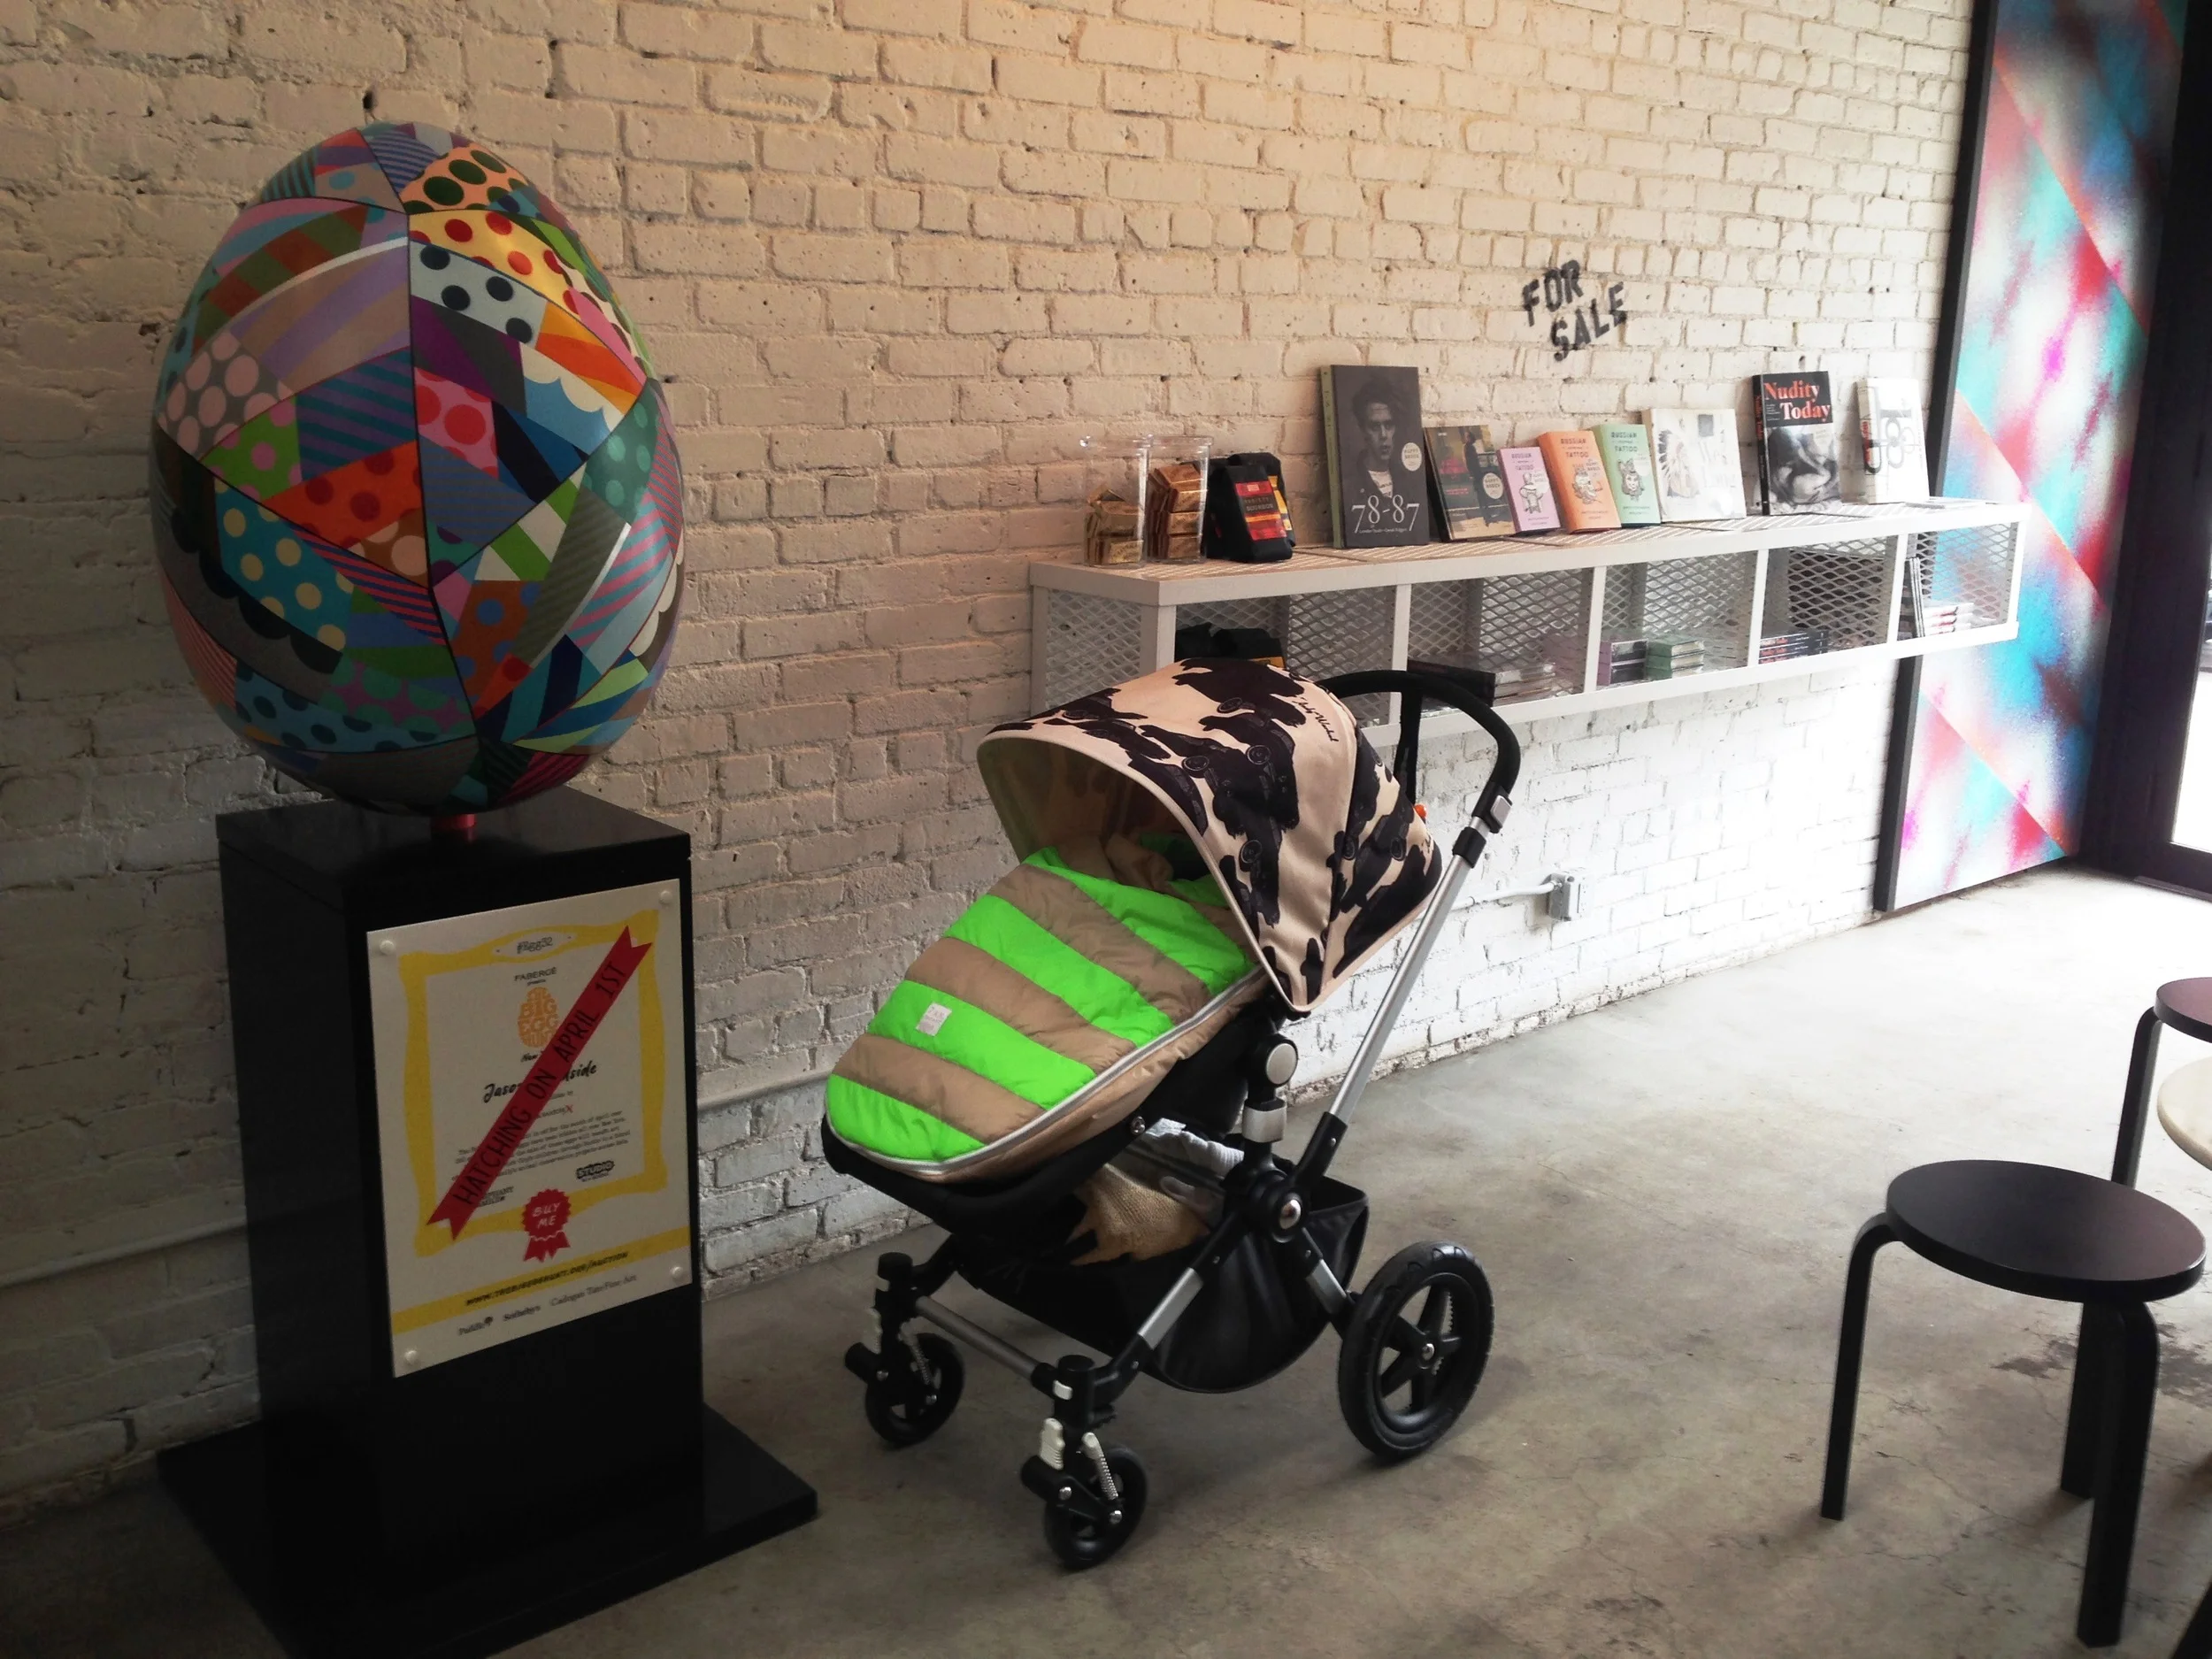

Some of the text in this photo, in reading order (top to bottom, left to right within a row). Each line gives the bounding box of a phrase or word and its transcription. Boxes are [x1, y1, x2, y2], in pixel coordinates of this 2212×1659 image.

[1522, 259, 1584, 327] FOR
[1550, 281, 1627, 362] SALE
[1764, 379, 1820, 403] Nudity
[1779, 401, 1831, 422] Today
[1351, 494, 1420, 534] 78-87
[483, 1083, 523, 1103] Jaso
[454, 1104, 531, 1205] HATCHING
[526, 1067, 557, 1101] ON
[552, 1010, 601, 1063] APRIL
[576, 1160, 615, 1179] STUDIO
[533, 1202, 561, 1218] BUY
[537, 1216, 557, 1229] ME
